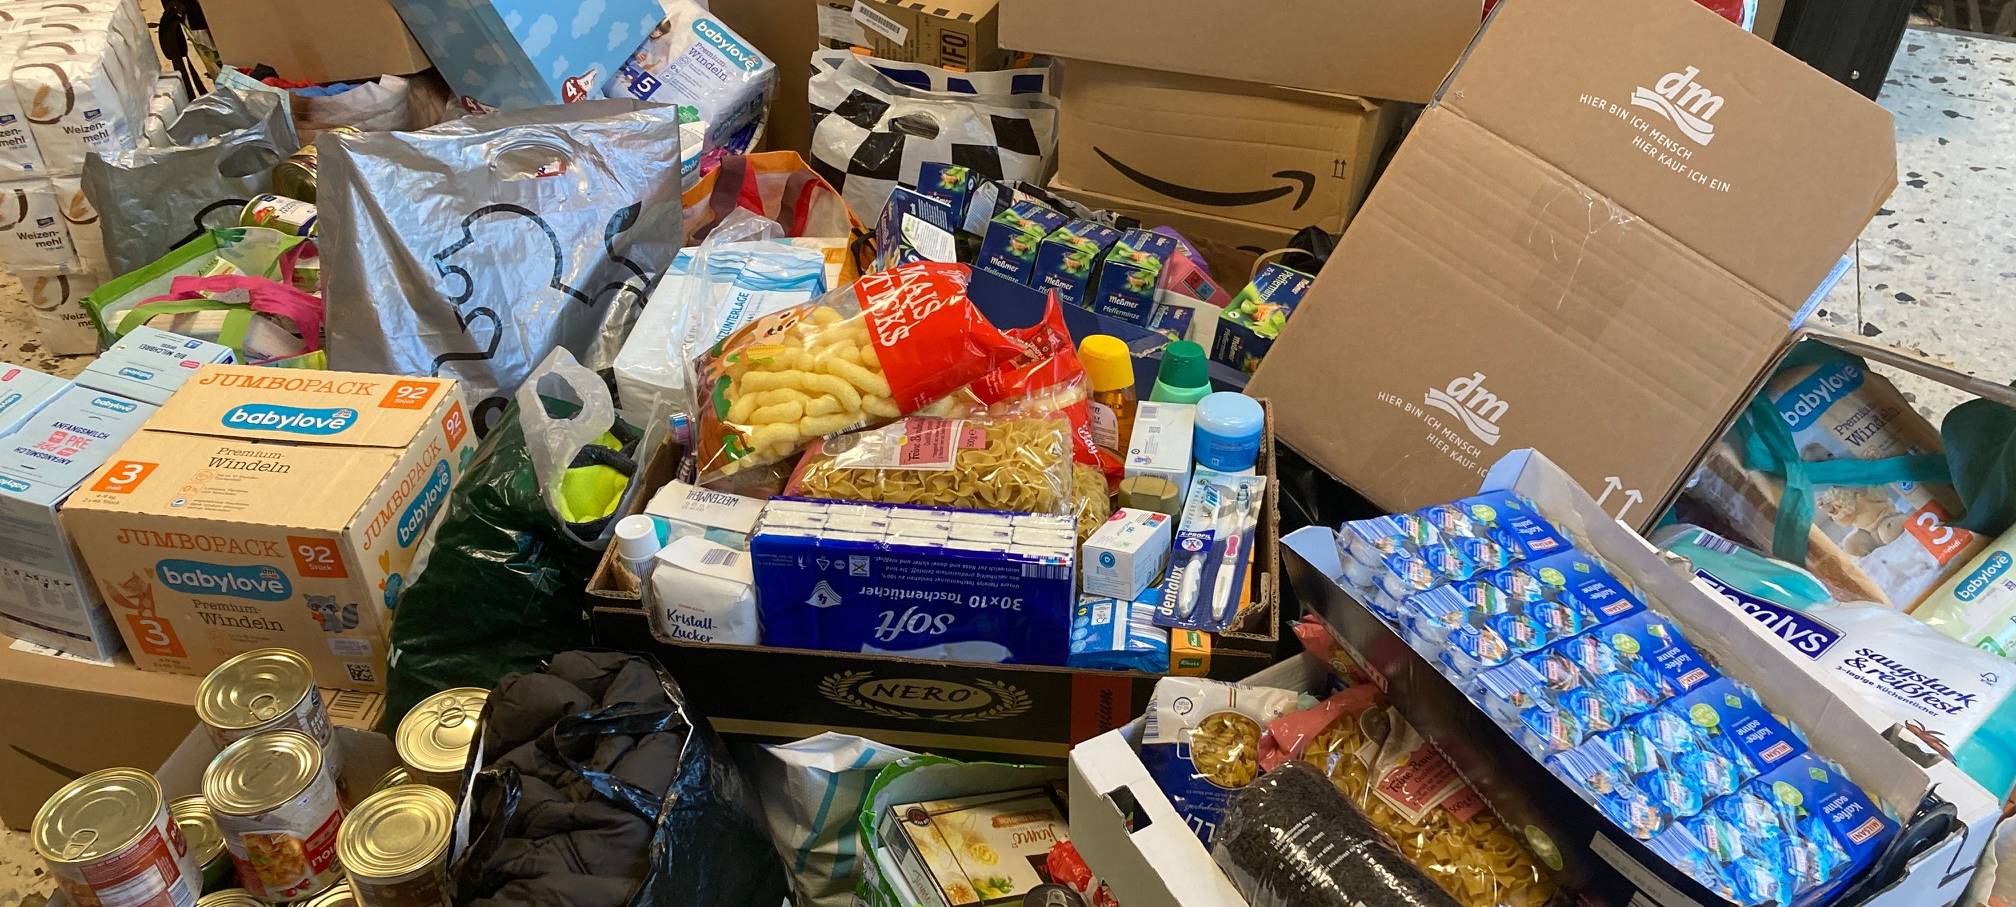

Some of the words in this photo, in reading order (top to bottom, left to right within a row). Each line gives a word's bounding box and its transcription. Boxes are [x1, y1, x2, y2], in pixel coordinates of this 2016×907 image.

[696, 20, 756, 70] babylove
[687, 48, 728, 82] Windeln
[636, 76, 653, 93] 5
[1655, 65, 1725, 121] dm
[0, 128, 22, 138] zen-
[62, 122, 106, 135] Weizen-
[83, 129, 110, 144] mehl
[1579, 93, 1608, 110] HIER
[1609, 103, 1630, 120] BIN
[1630, 116, 1650, 132] ICH
[1649, 128, 1693, 161] MENSCH
[1632, 135, 1658, 158] HIER
[1657, 153, 1687, 174] KAUF
[1688, 169, 1708, 185] ICH
[1710, 178, 1731, 193] EIN
[17, 230, 60, 240] Weizen-
[35, 238, 62, 249] mehl
[990, 256, 1020, 273] Meßmer
[896, 263, 942, 320] MAIS
[1044, 274, 1074, 292] Meßmer
[862, 269, 911, 347] TICKS
[1109, 293, 1140, 310] Meßmer
[62, 312, 88, 321] Weiz
[1102, 305, 1141, 320] Pfefferminze
[199, 372, 380, 397] JUMBOPACK
[397, 386, 428, 399] 92
[1780, 363, 1859, 427] babylove
[93, 398, 134, 413] babylove
[1445, 371, 1509, 423] dm
[230, 408, 346, 431] babylove
[446, 411, 462, 436] 92
[1377, 391, 1402, 408] HIER
[1404, 402, 1424, 418] BIN
[1423, 414, 1442, 431] ICH
[1441, 427, 1481, 459] MENSCH
[52, 421, 110, 440] ANFANGSMILCH
[66, 435, 92, 450] PRE
[217, 447, 286, 460] Premium-
[1426, 432, 1450, 454] HIER
[1449, 450, 1476, 470] KAUF
[1477, 466, 1489, 478] IC
[108, 463, 144, 485] 3
[207, 457, 292, 475] Windeln
[363, 437, 442, 551] JUMBOPACK
[400, 472, 449, 543] babylove
[1916, 511, 1954, 545] 3
[117, 529, 287, 559] JUMBOPACK
[298, 545, 334, 563] 92
[163, 566, 285, 595] babylove
[1957, 555, 2009, 600] babylove
[858, 586, 963, 605] Taschentücher
[1162, 565, 1185, 616] dentalux
[192, 599, 262, 614] Premium-
[968, 595, 1024, 611] 30x10
[197, 612, 286, 632] Windeln
[666, 608, 718, 631] Kristall-
[139, 619, 171, 646] 3
[671, 623, 714, 644] Zucker
[1843, 656, 1867, 673] &
[1869, 667, 1969, 717] reißfest
[1854, 647, 1978, 709] saugstark
[872, 682, 970, 703] NERO
[1876, 683, 1939, 718] Küchentücher
[1738, 719, 1761, 736] sahne
[1746, 727, 1774, 744] Kaffee-
[1763, 744, 1789, 761] MILSANI
[1822, 796, 1849, 814] sahne
[1832, 802, 1864, 823] Kaffee-
[1852, 821, 1880, 841] MILSANI
